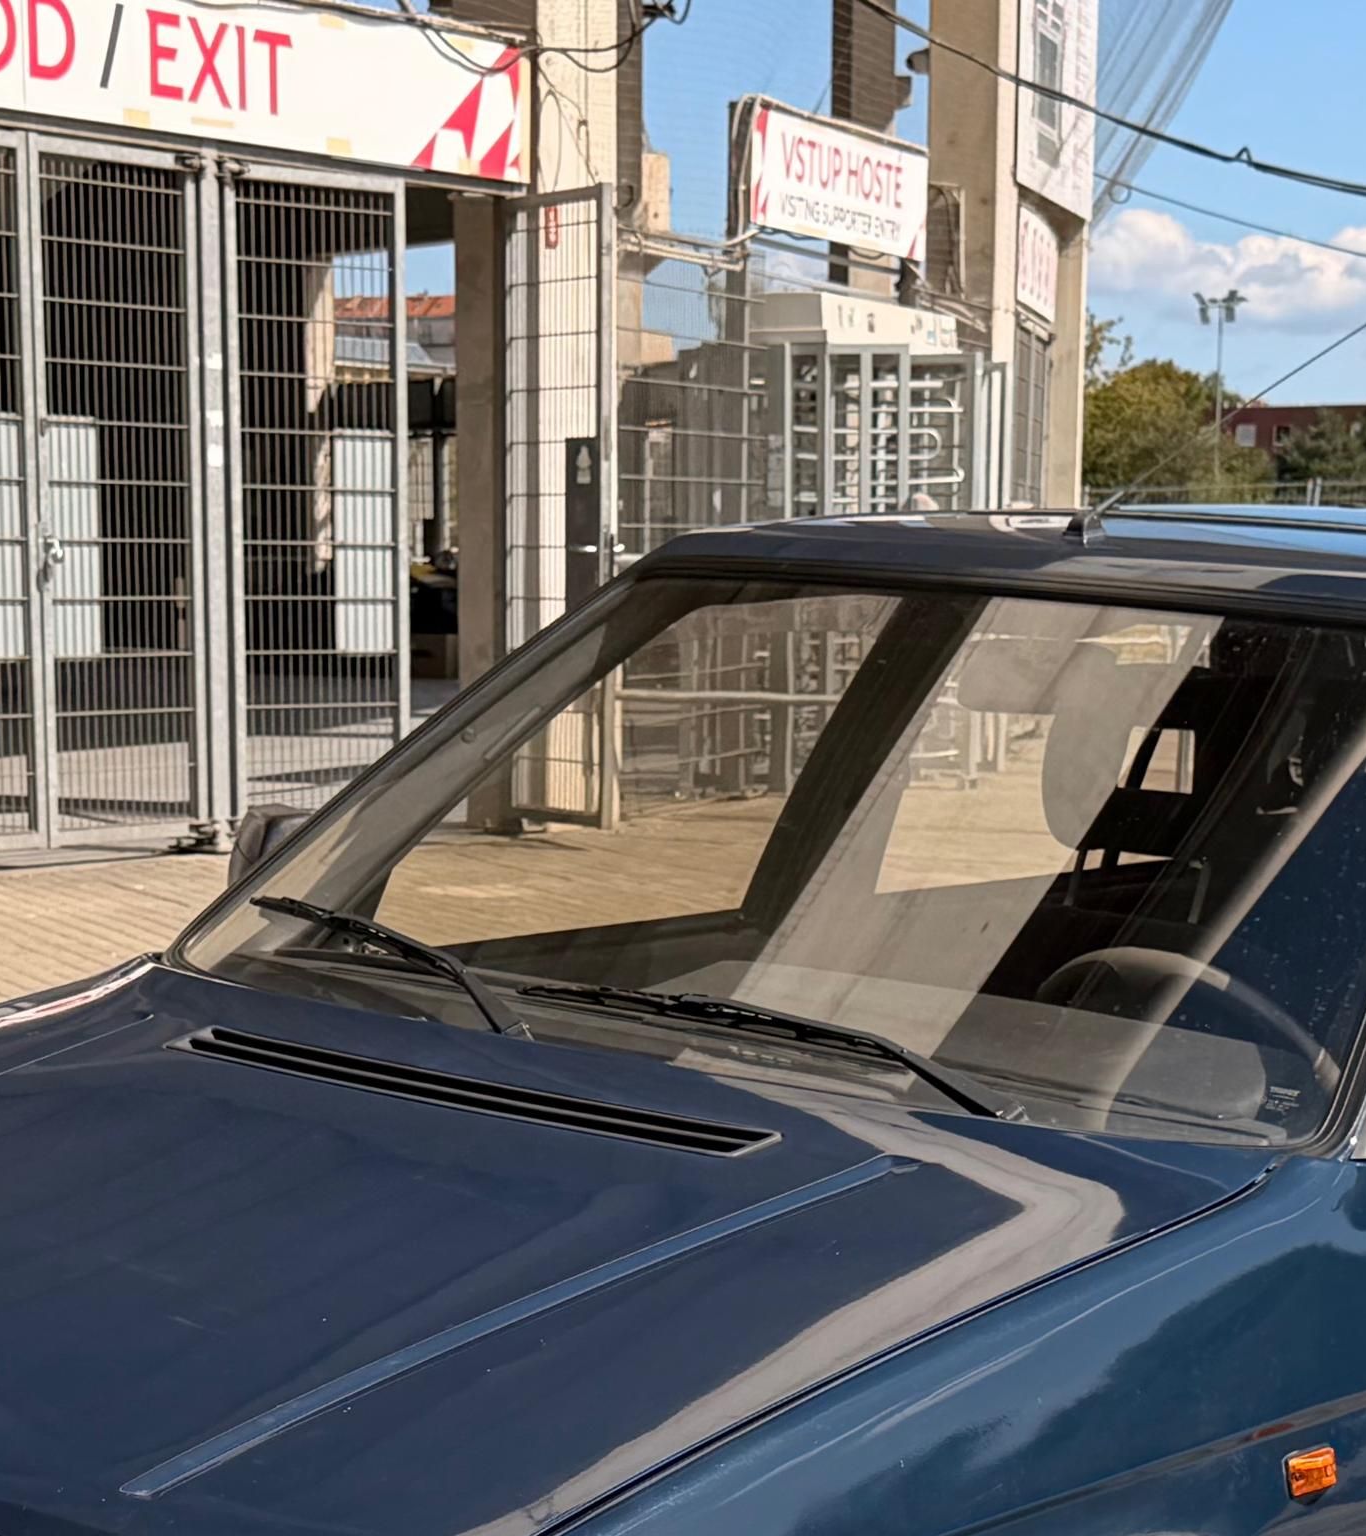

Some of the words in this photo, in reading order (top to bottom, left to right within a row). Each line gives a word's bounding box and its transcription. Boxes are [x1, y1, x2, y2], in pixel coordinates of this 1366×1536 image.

[146, 9, 293, 115] EXIT
[781, 132, 843, 191] VSTUP
[847, 153, 903, 208] HOSTÉ
